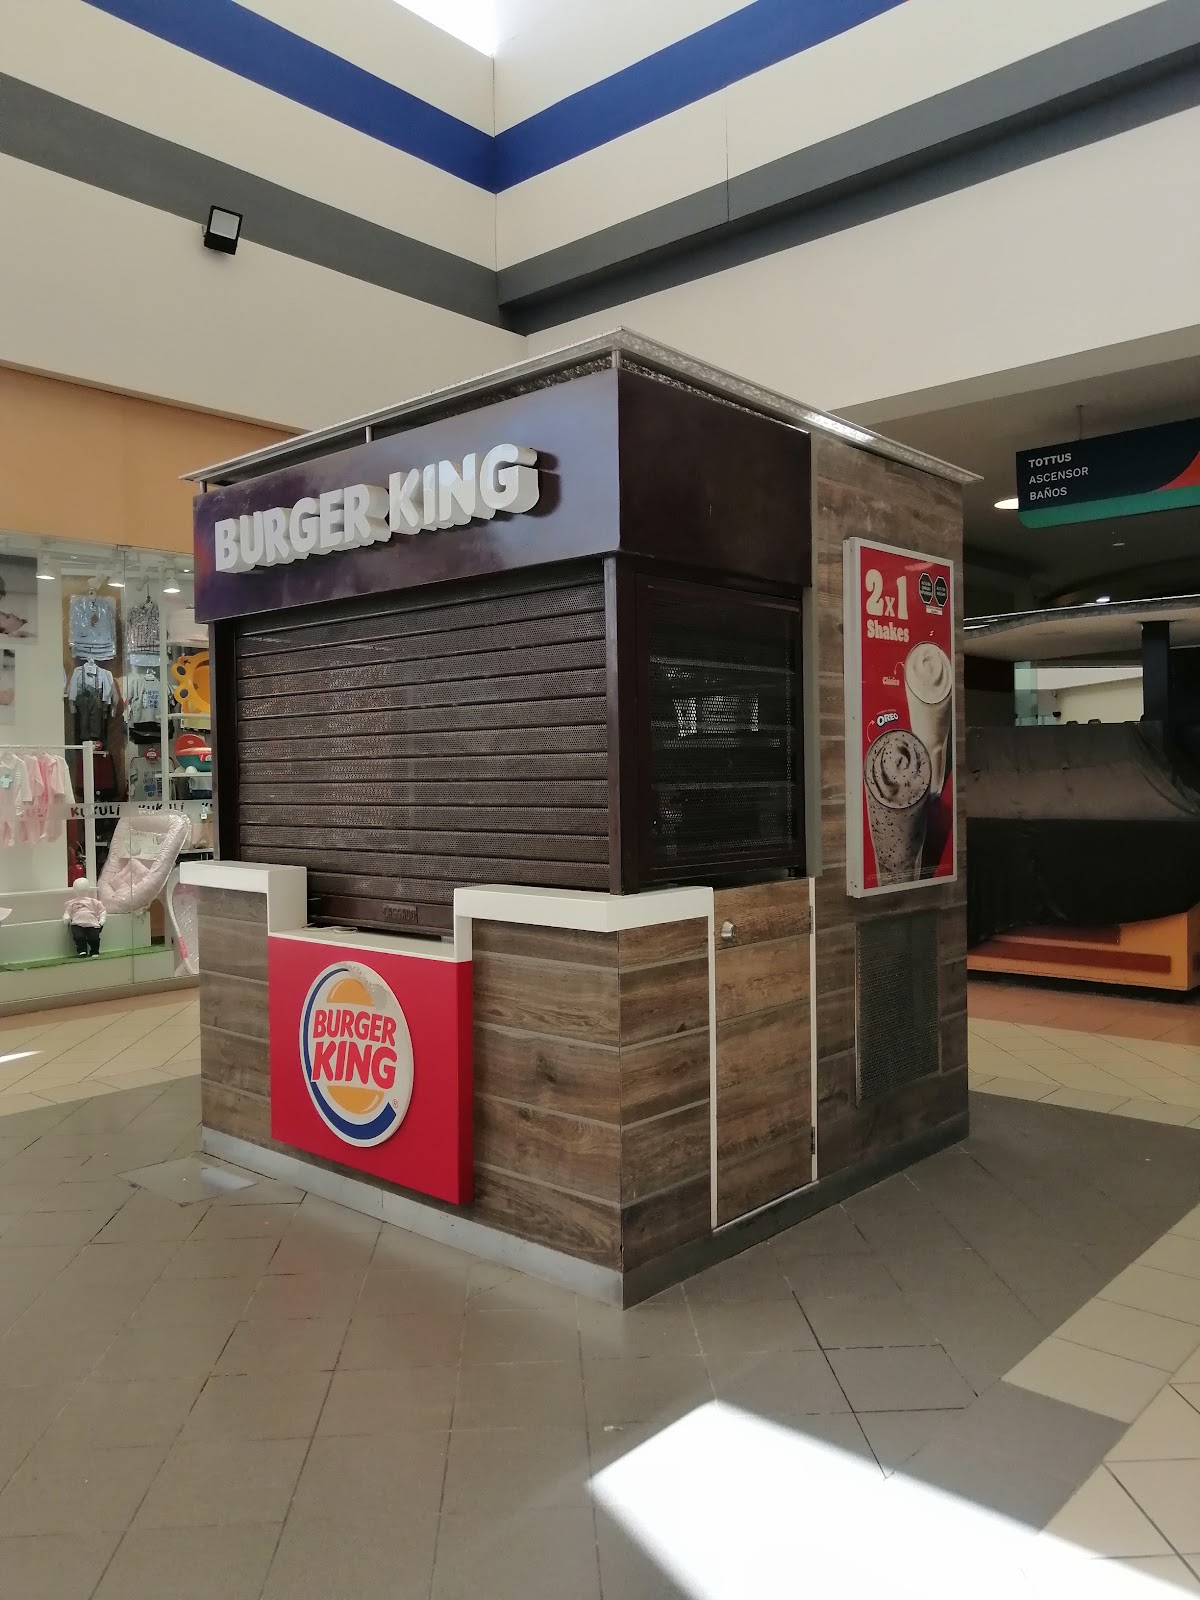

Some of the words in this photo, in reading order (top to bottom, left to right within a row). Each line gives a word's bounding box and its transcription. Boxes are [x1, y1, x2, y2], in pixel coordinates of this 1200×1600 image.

[1028, 452, 1072, 468] TOTTUS
[1028, 466, 1089, 485] ASCENSOR
[1029, 487, 1068, 501] BAÑOS
[214, 483, 389, 573] BURGER
[389, 443, 537, 534] KING
[865, 569, 909, 620] 2x1
[866, 619, 910, 643] Shakes
[876, 713, 899, 727] OREO
[312, 1009, 397, 1047] BURGER
[311, 1040, 398, 1090] KING
